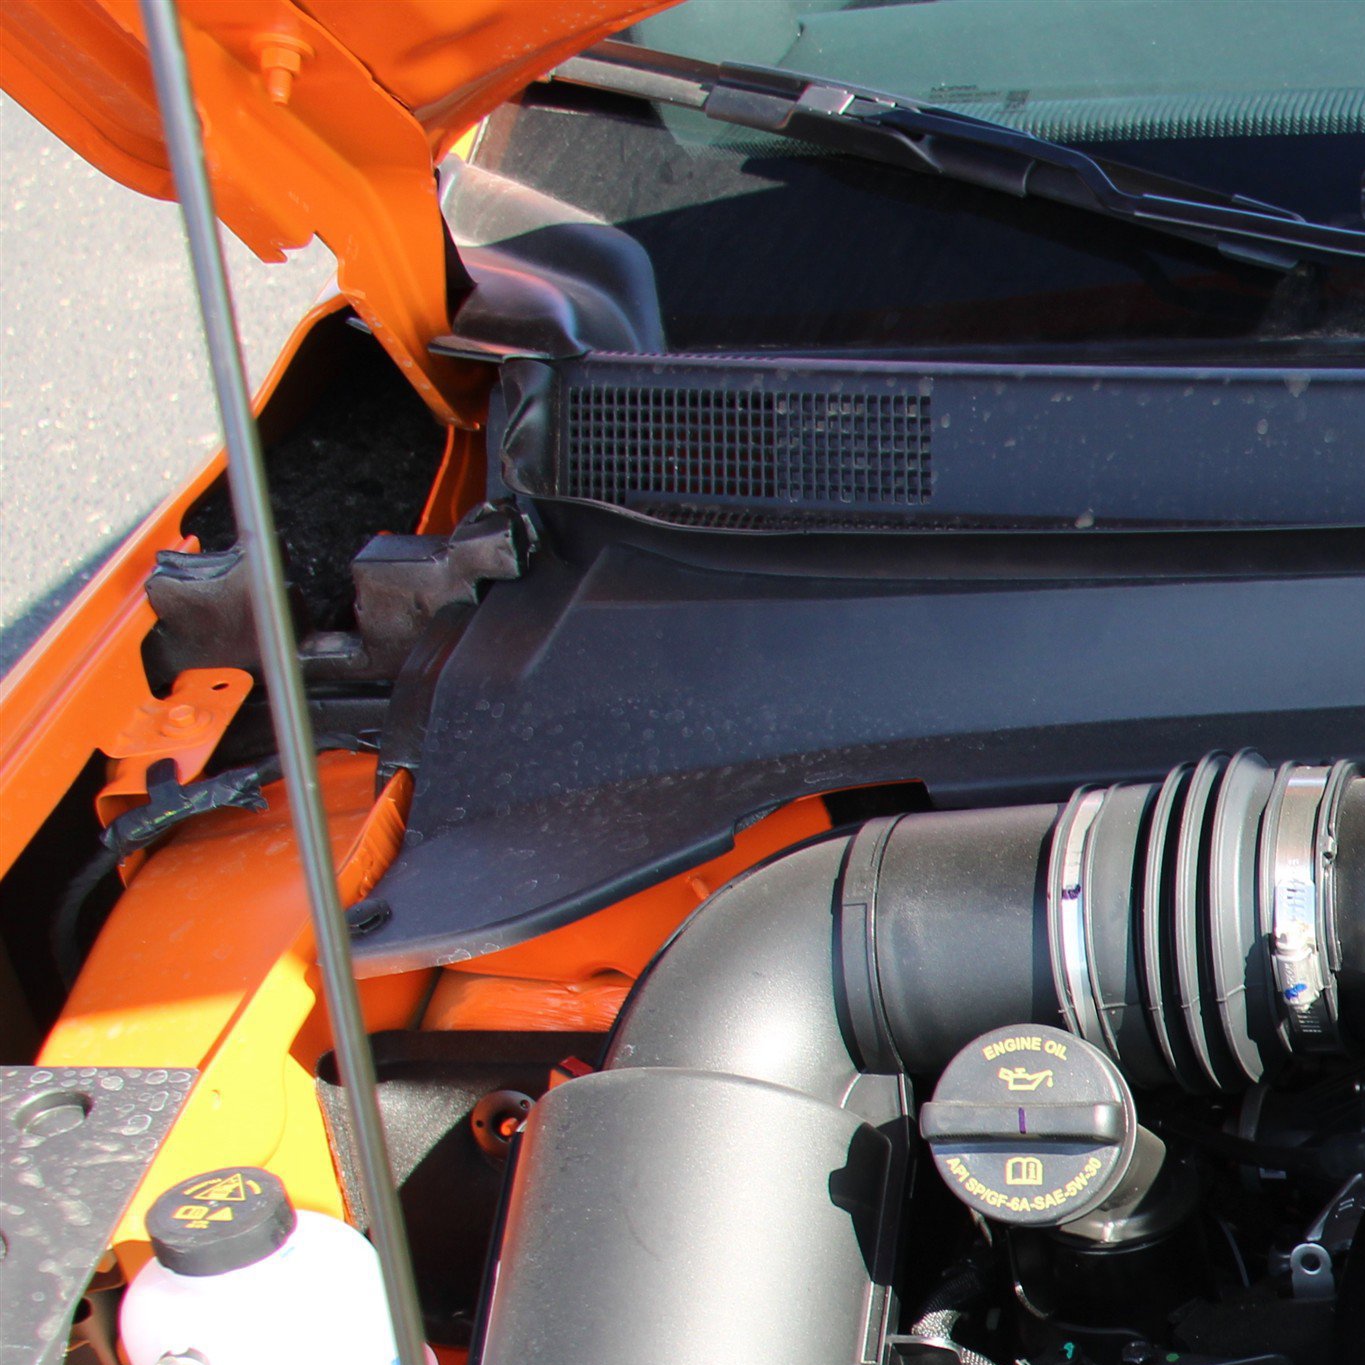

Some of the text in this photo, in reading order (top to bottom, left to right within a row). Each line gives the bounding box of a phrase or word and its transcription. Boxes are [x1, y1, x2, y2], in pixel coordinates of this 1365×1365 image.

[982, 1036, 1069, 1062] ENGINE OIL
[946, 1156, 969, 1184] API
